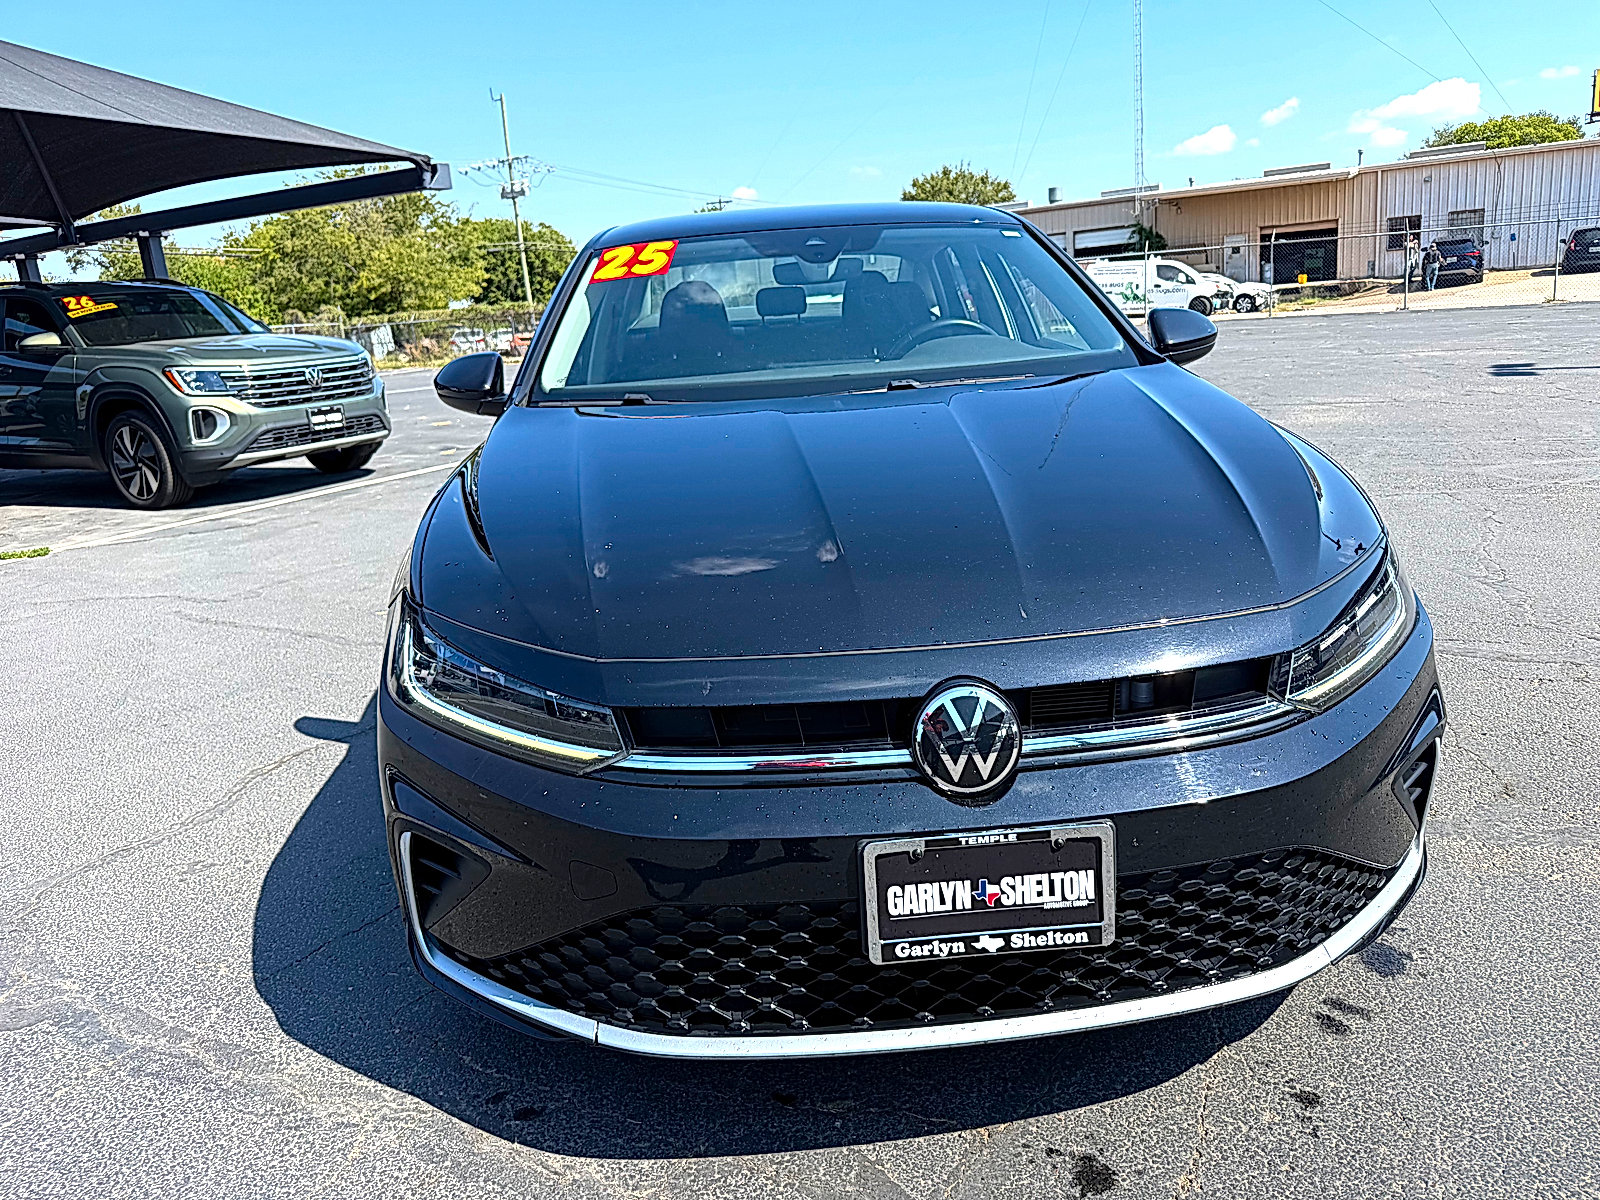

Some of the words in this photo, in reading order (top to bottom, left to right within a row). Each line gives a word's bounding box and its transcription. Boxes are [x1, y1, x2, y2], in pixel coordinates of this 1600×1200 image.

[593, 241, 675, 280] 25
[63, 296, 95, 310] 26
[919, 690, 1010, 785] VW
[958, 833, 1017, 845] TEMPLE
[887, 880, 972, 916] GARLYN
[1000, 869, 1095, 906] SHELTON
[895, 940, 965, 958] Garlyn
[1010, 929, 1088, 948] Shelton
